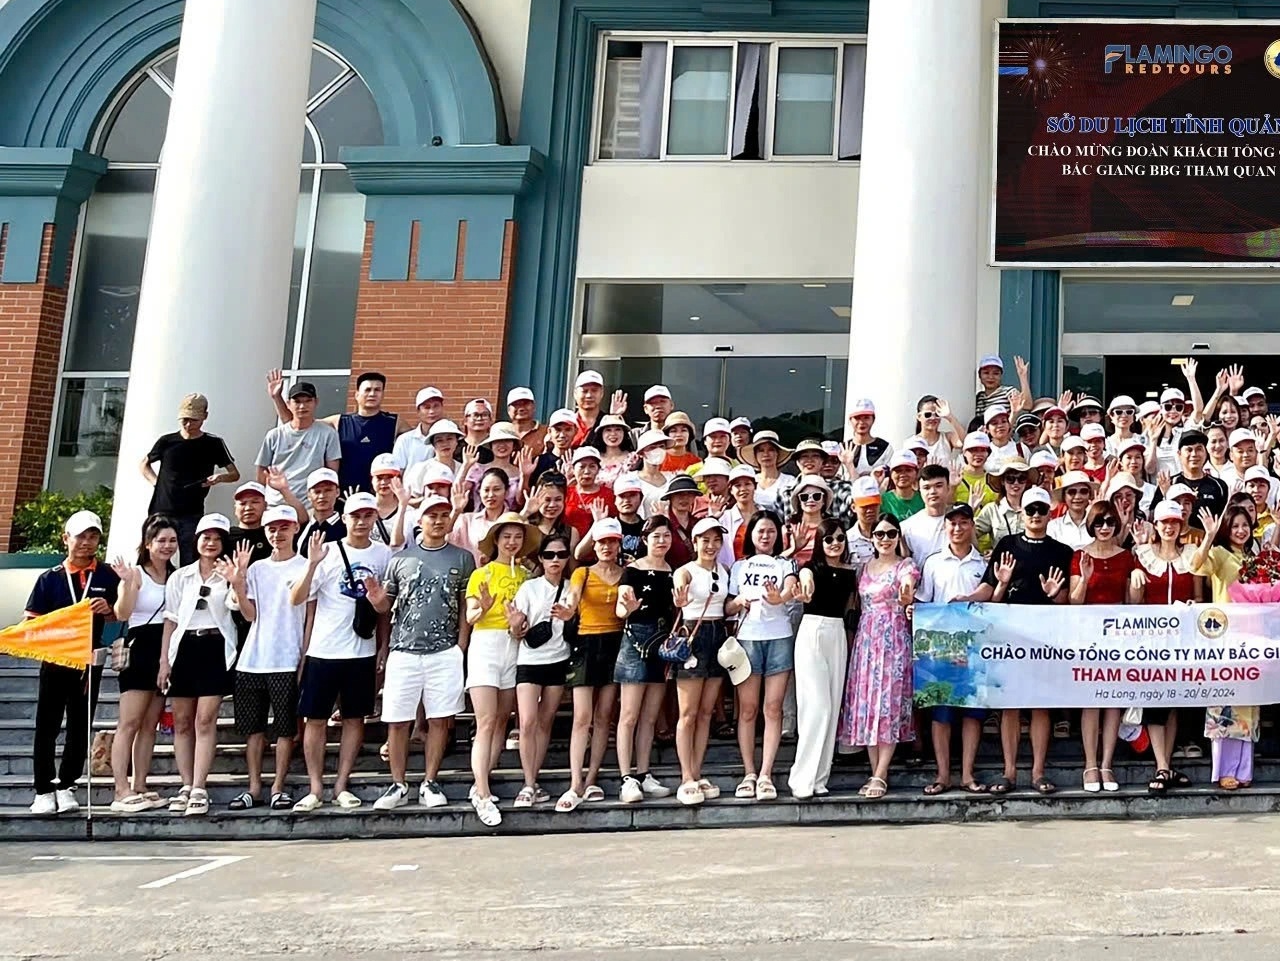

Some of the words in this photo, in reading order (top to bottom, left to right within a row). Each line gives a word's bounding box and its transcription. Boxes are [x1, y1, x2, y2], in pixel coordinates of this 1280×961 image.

[1104, 45, 1233, 73] FLAMINGO
[1125, 64, 1233, 74] REDTOURS
[1046, 113, 1076, 134] SỞ
[1079, 117, 1110, 134] DU
[1113, 117, 1167, 137] LỊCH
[1170, 113, 1225, 135] TỈNH
[1027, 142, 1072, 157] CHÀO
[1075, 142, 1122, 157] MỪNG
[1126, 143, 1169, 157] ĐOÀN
[1173, 143, 1229, 158] KHÁCH
[1096, 164, 1146, 177] GIANG
[1149, 165, 1181, 177] BBG
[1184, 165, 1230, 177] THAM
[1233, 165, 1277, 178] QUAN
[743, 572, 760, 586] XE
[1103, 617, 1180, 635] FLAMINGO
[981, 643, 1026, 660] CHÀO
[1030, 643, 1075, 660] MỪNG
[1079, 643, 1121, 661] TỔNG
[1124, 646, 1171, 661] CÔNG
[1175, 648, 1190, 661] TY
[1194, 648, 1225, 661] MAY
[1229, 642, 1260, 660] BẮC
[1072, 668, 1121, 682] THAM
[1126, 668, 1177, 682] QUAN
[1181, 668, 1206, 685] HẠ
[1211, 667, 1260, 681] LONG
[1111, 689, 1137, 701] Long,
[1167, 689, 1177, 698] 18
